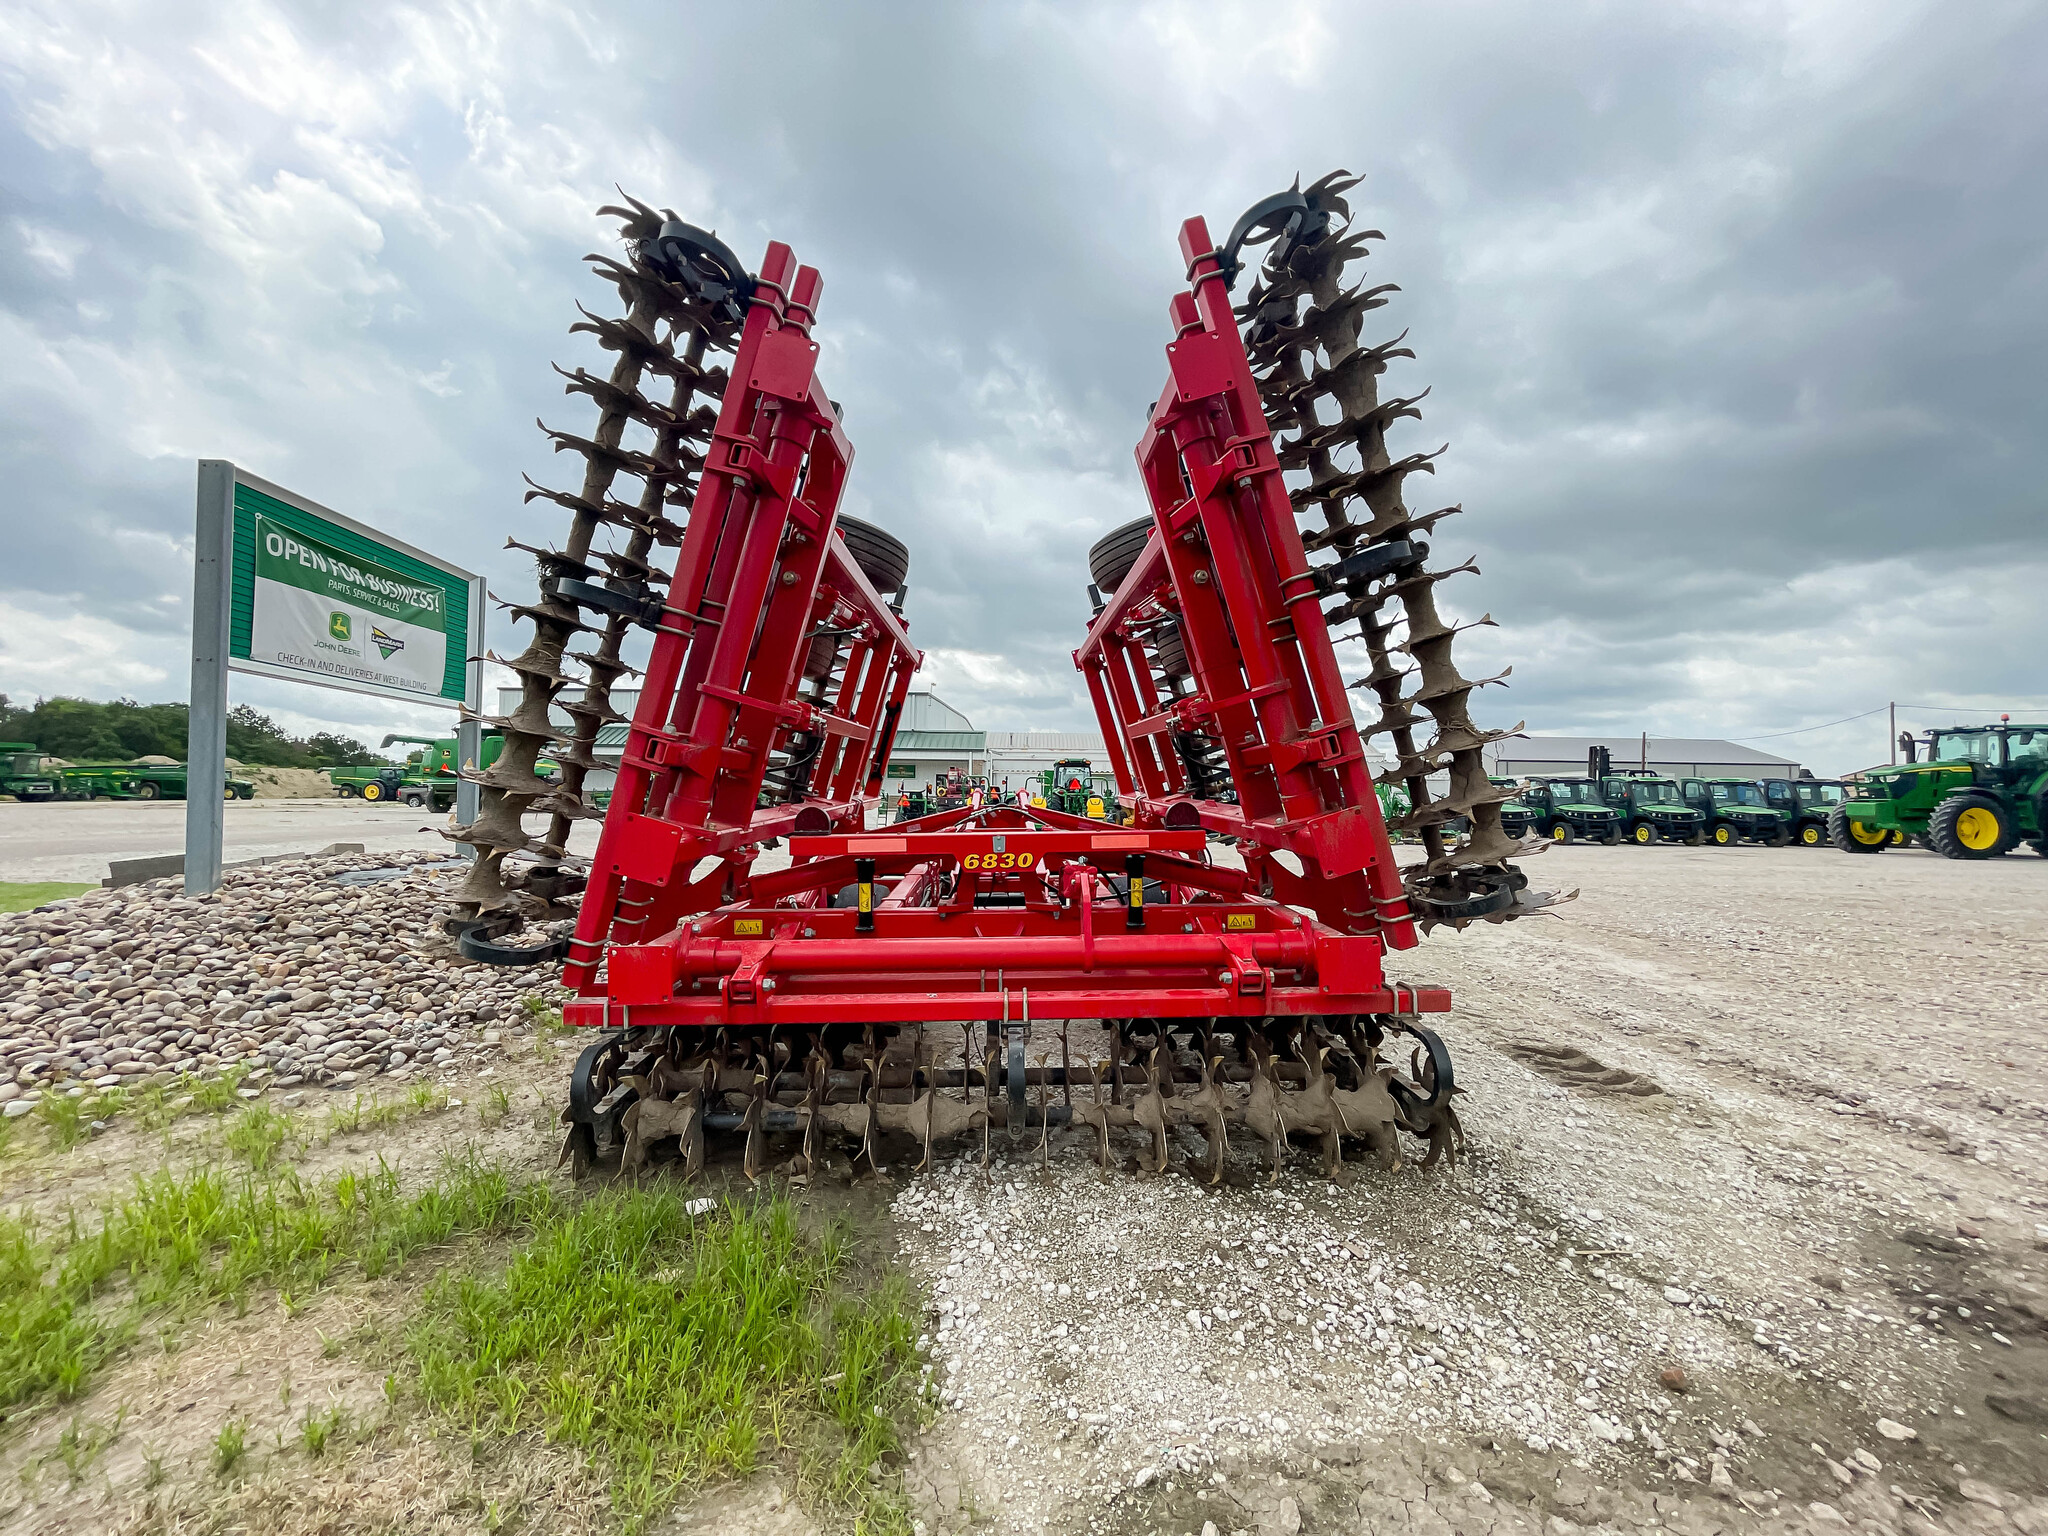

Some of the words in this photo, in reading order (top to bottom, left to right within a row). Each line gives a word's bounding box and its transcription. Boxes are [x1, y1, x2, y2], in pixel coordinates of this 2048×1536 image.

[266, 532, 327, 573] OPEN
[326, 556, 366, 587] FOR
[364, 573, 439, 613] BUSINESS!
[328, 579, 352, 596] PARTS,
[352, 588, 378, 605] SERVICE
[376, 598, 382, 607] &
[382, 599, 400, 613] SALES
[313, 638, 336, 652] JOHN
[337, 644, 361, 658] DEERE
[277, 652, 316, 669] CHECK-IN
[317, 660, 335, 672] AND
[335, 664, 374, 680] DELIVERIES
[373, 672, 382, 681] AT
[382, 674, 399, 685] WEST
[399, 678, 428, 691] BUILDING
[963, 852, 1034, 870] 6830
